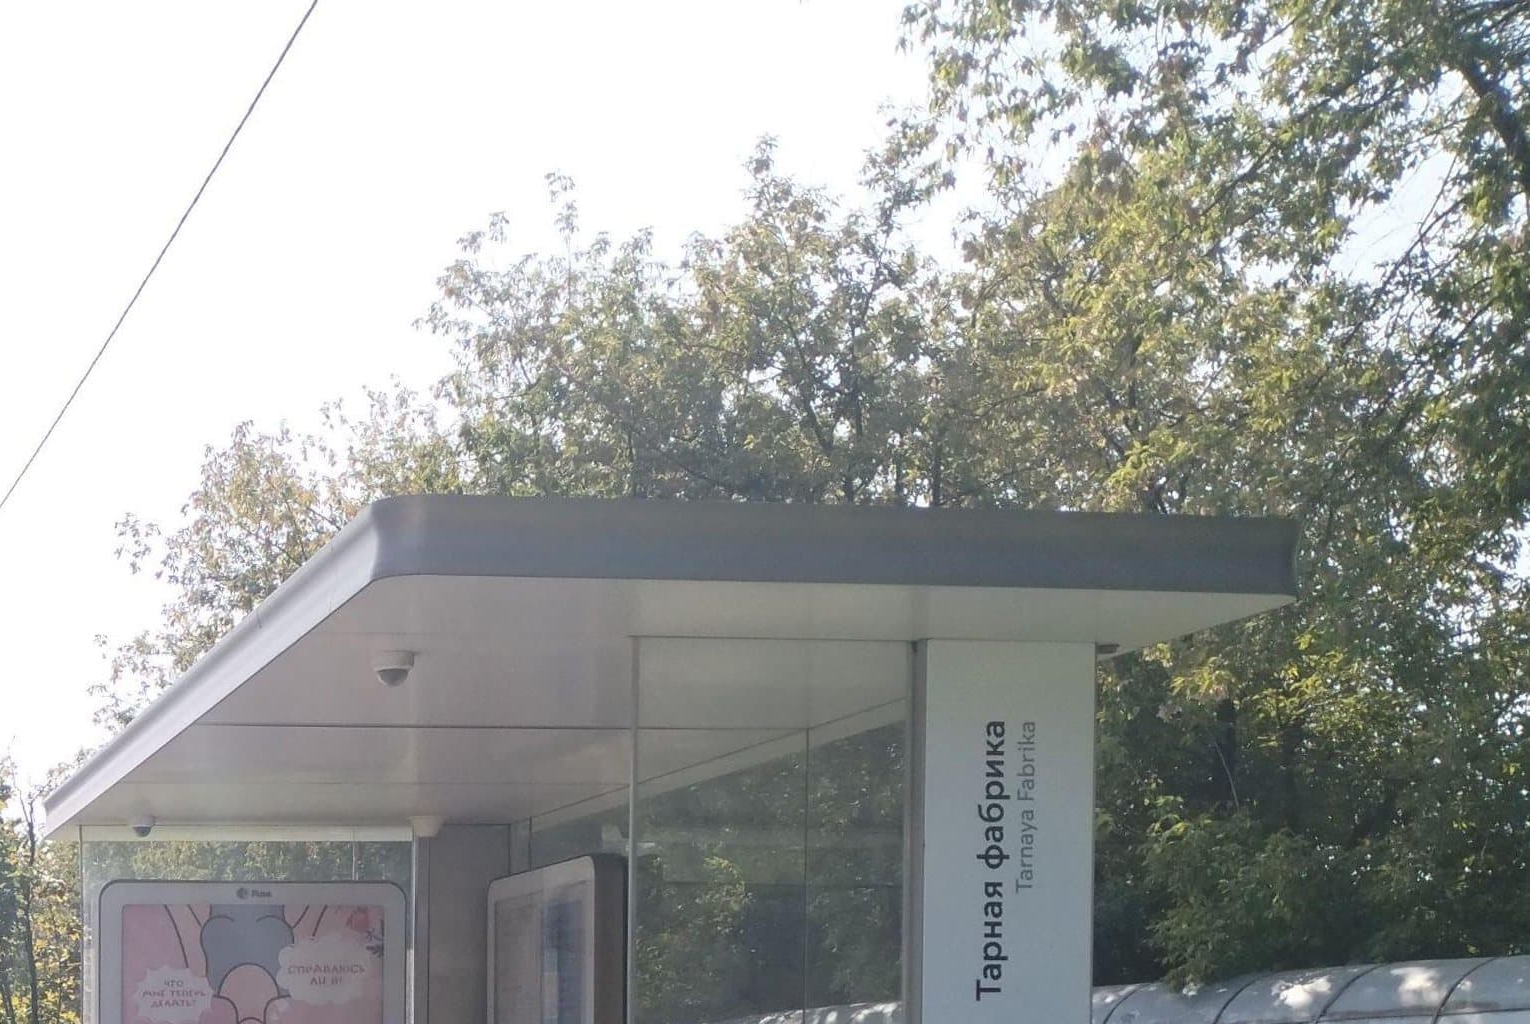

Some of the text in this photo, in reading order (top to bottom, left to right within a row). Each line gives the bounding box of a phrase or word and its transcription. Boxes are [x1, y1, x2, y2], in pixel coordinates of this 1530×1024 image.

[976, 721, 1011, 1001] Тарная фабрика
[1016, 721, 1038, 894] Tarnaya Fabrika
